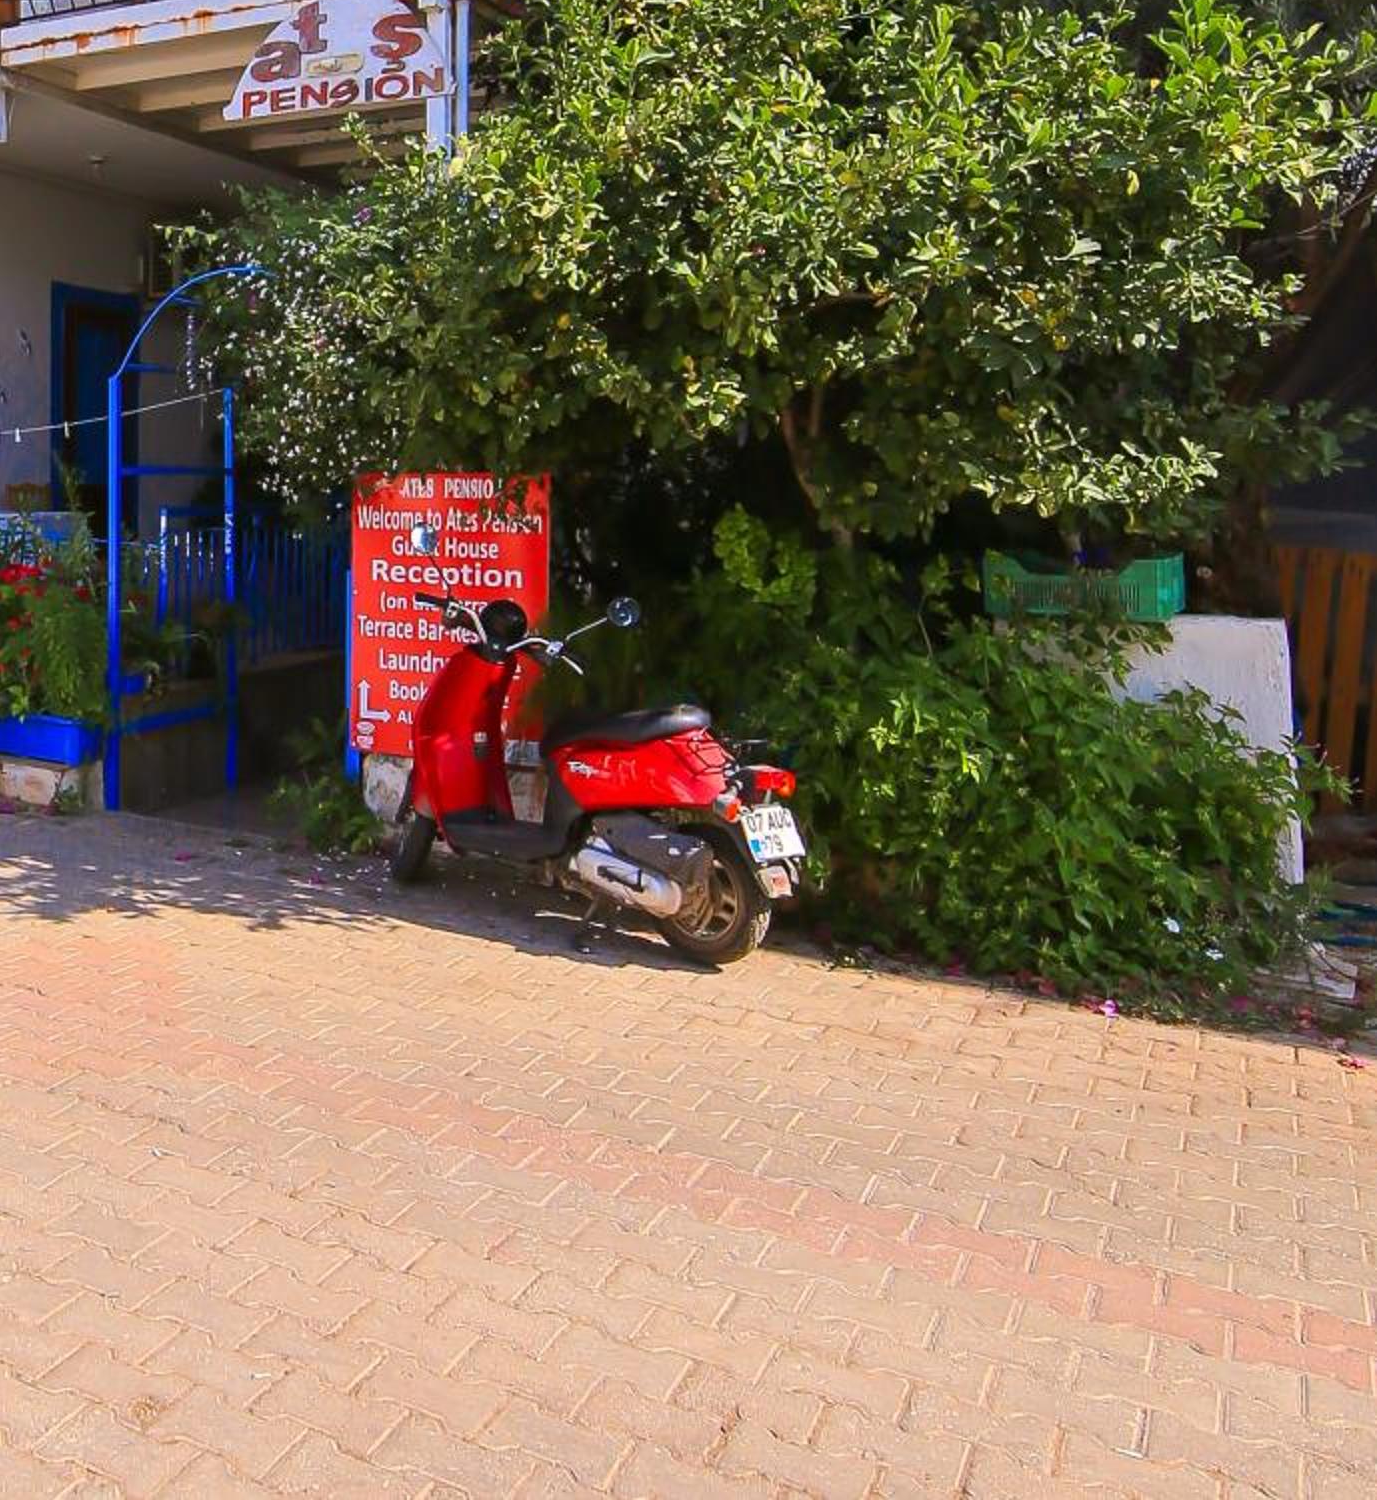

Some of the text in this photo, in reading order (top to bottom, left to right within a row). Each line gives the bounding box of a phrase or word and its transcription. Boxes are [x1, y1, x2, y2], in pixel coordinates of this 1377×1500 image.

[357, 504, 423, 531] Welcome
[426, 507, 442, 532] to
[445, 537, 499, 559] House
[371, 559, 523, 590] Reception
[380, 591, 407, 612] (on
[358, 614, 413, 639] Terrace
